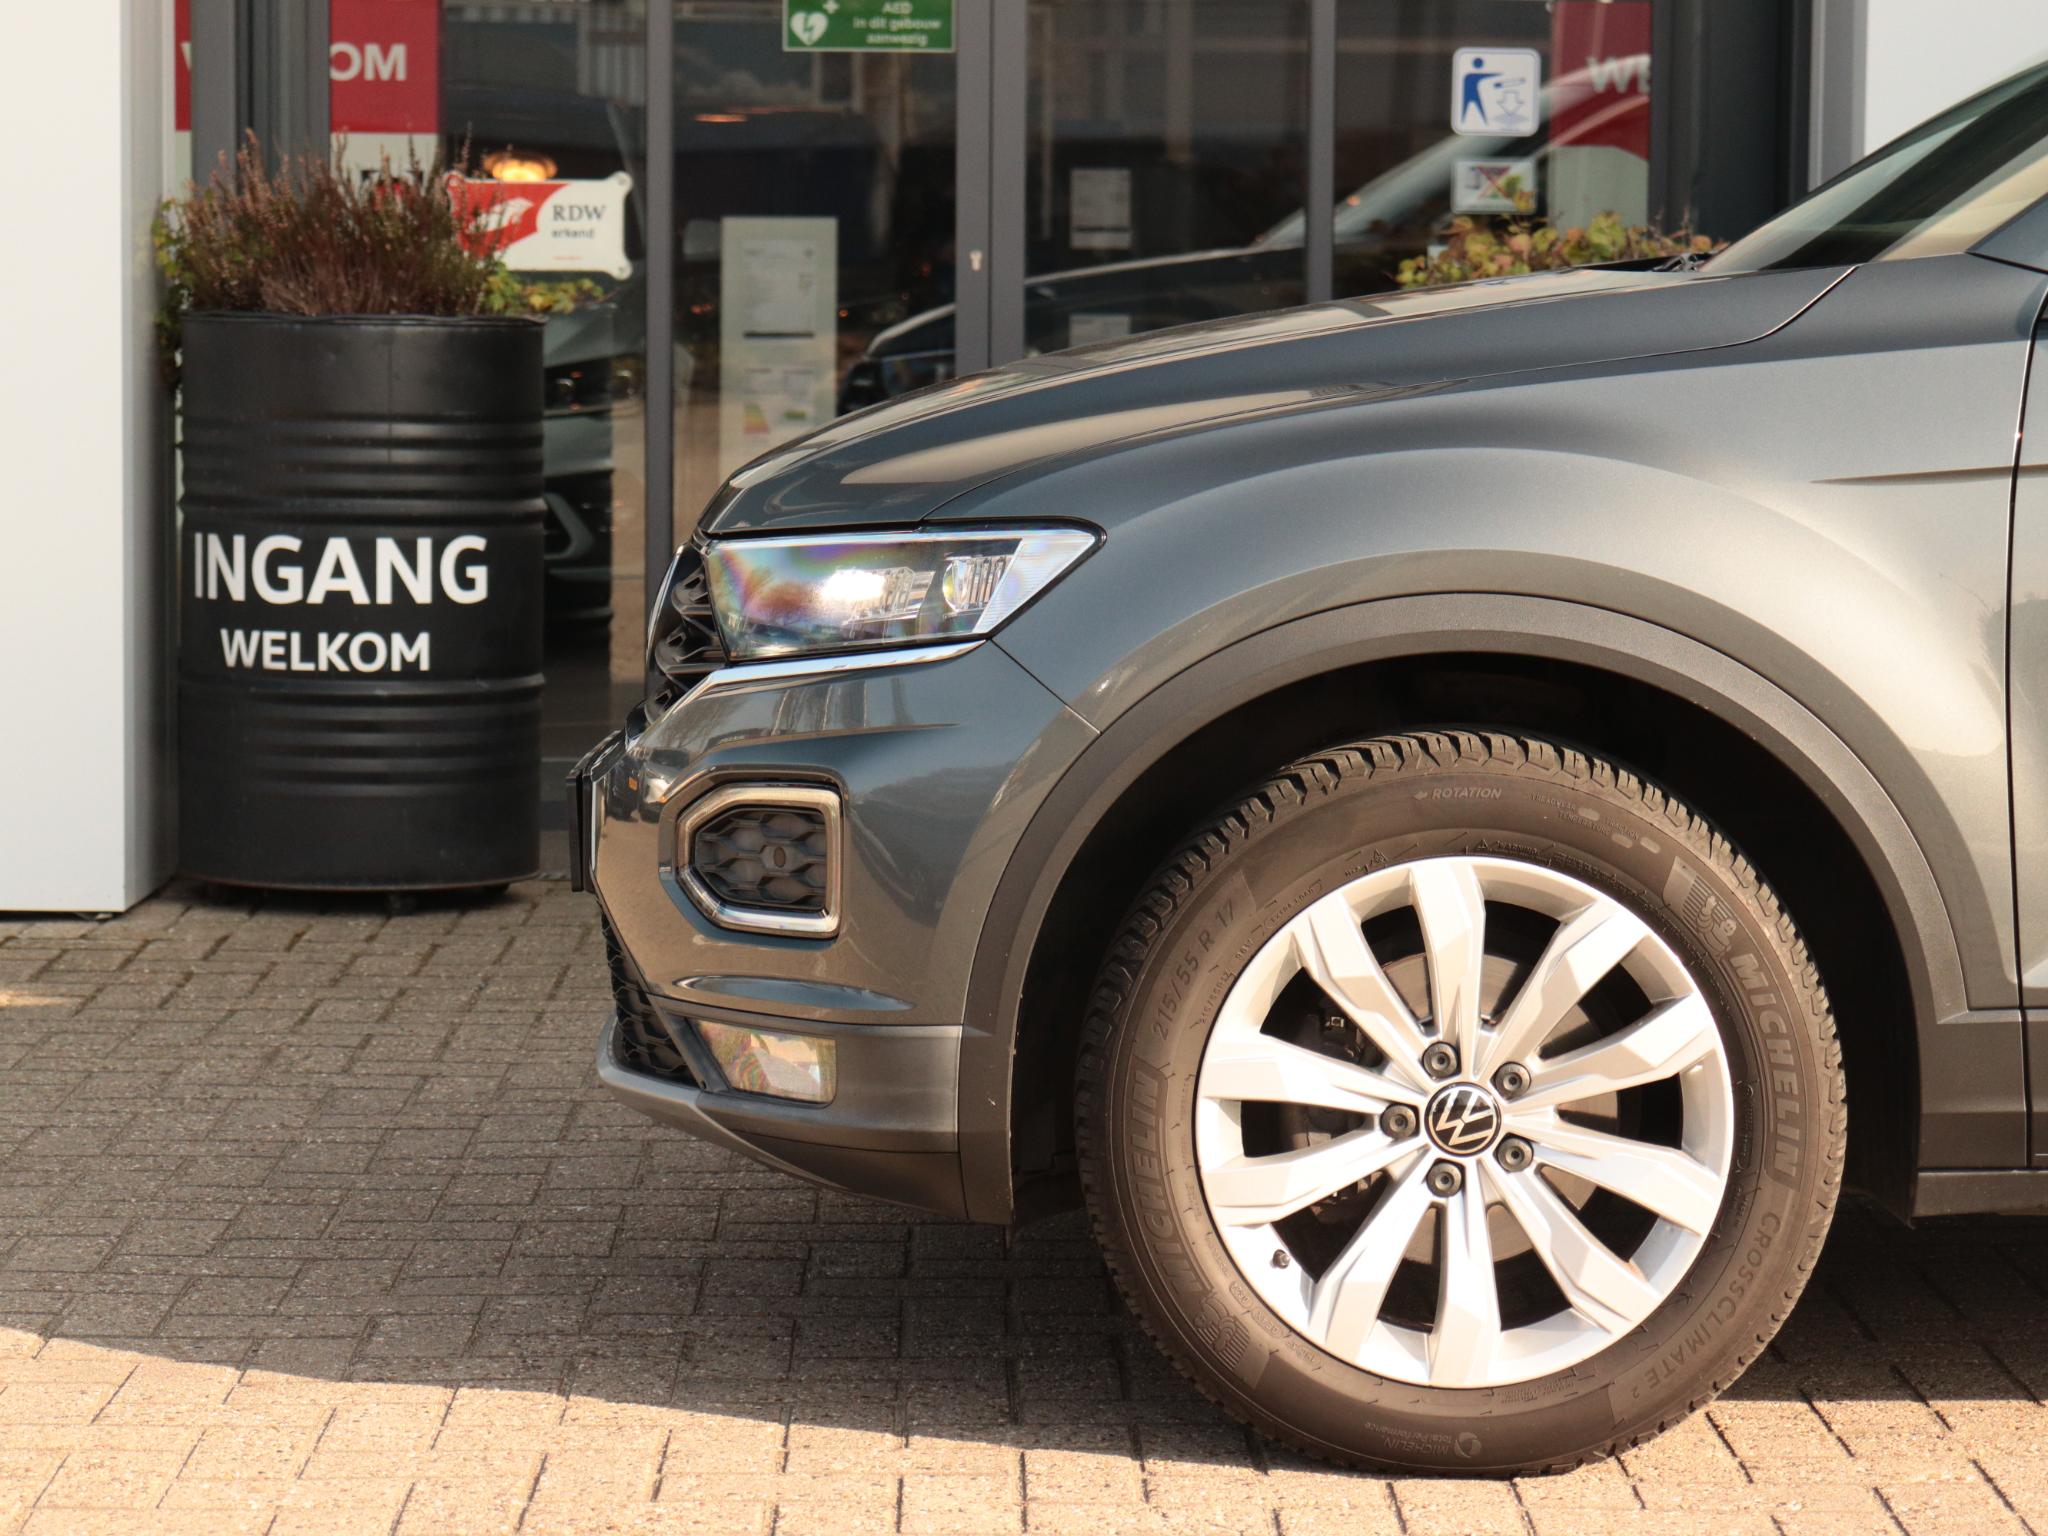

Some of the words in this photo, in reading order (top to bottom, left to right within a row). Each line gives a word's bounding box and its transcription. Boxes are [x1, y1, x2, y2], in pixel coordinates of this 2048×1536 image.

[853, 17, 867, 29] in
[869, 17, 887, 29] dit
[553, 204, 606, 221] RDW
[552, 228, 594, 239] erkend
[195, 532, 489, 605] INGANG
[220, 628, 431, 673] WELKOM
[1430, 786, 1501, 800] ROTATION
[1151, 954, 1199, 1041] 215/55
[1198, 929, 1216, 952] R
[1214, 899, 1237, 929] 17
[1730, 953, 1801, 1173] MICHELIN
[1131, 1071, 1200, 1295] MICHELIN
[1383, 1437, 1449, 1456] MICHELIN
